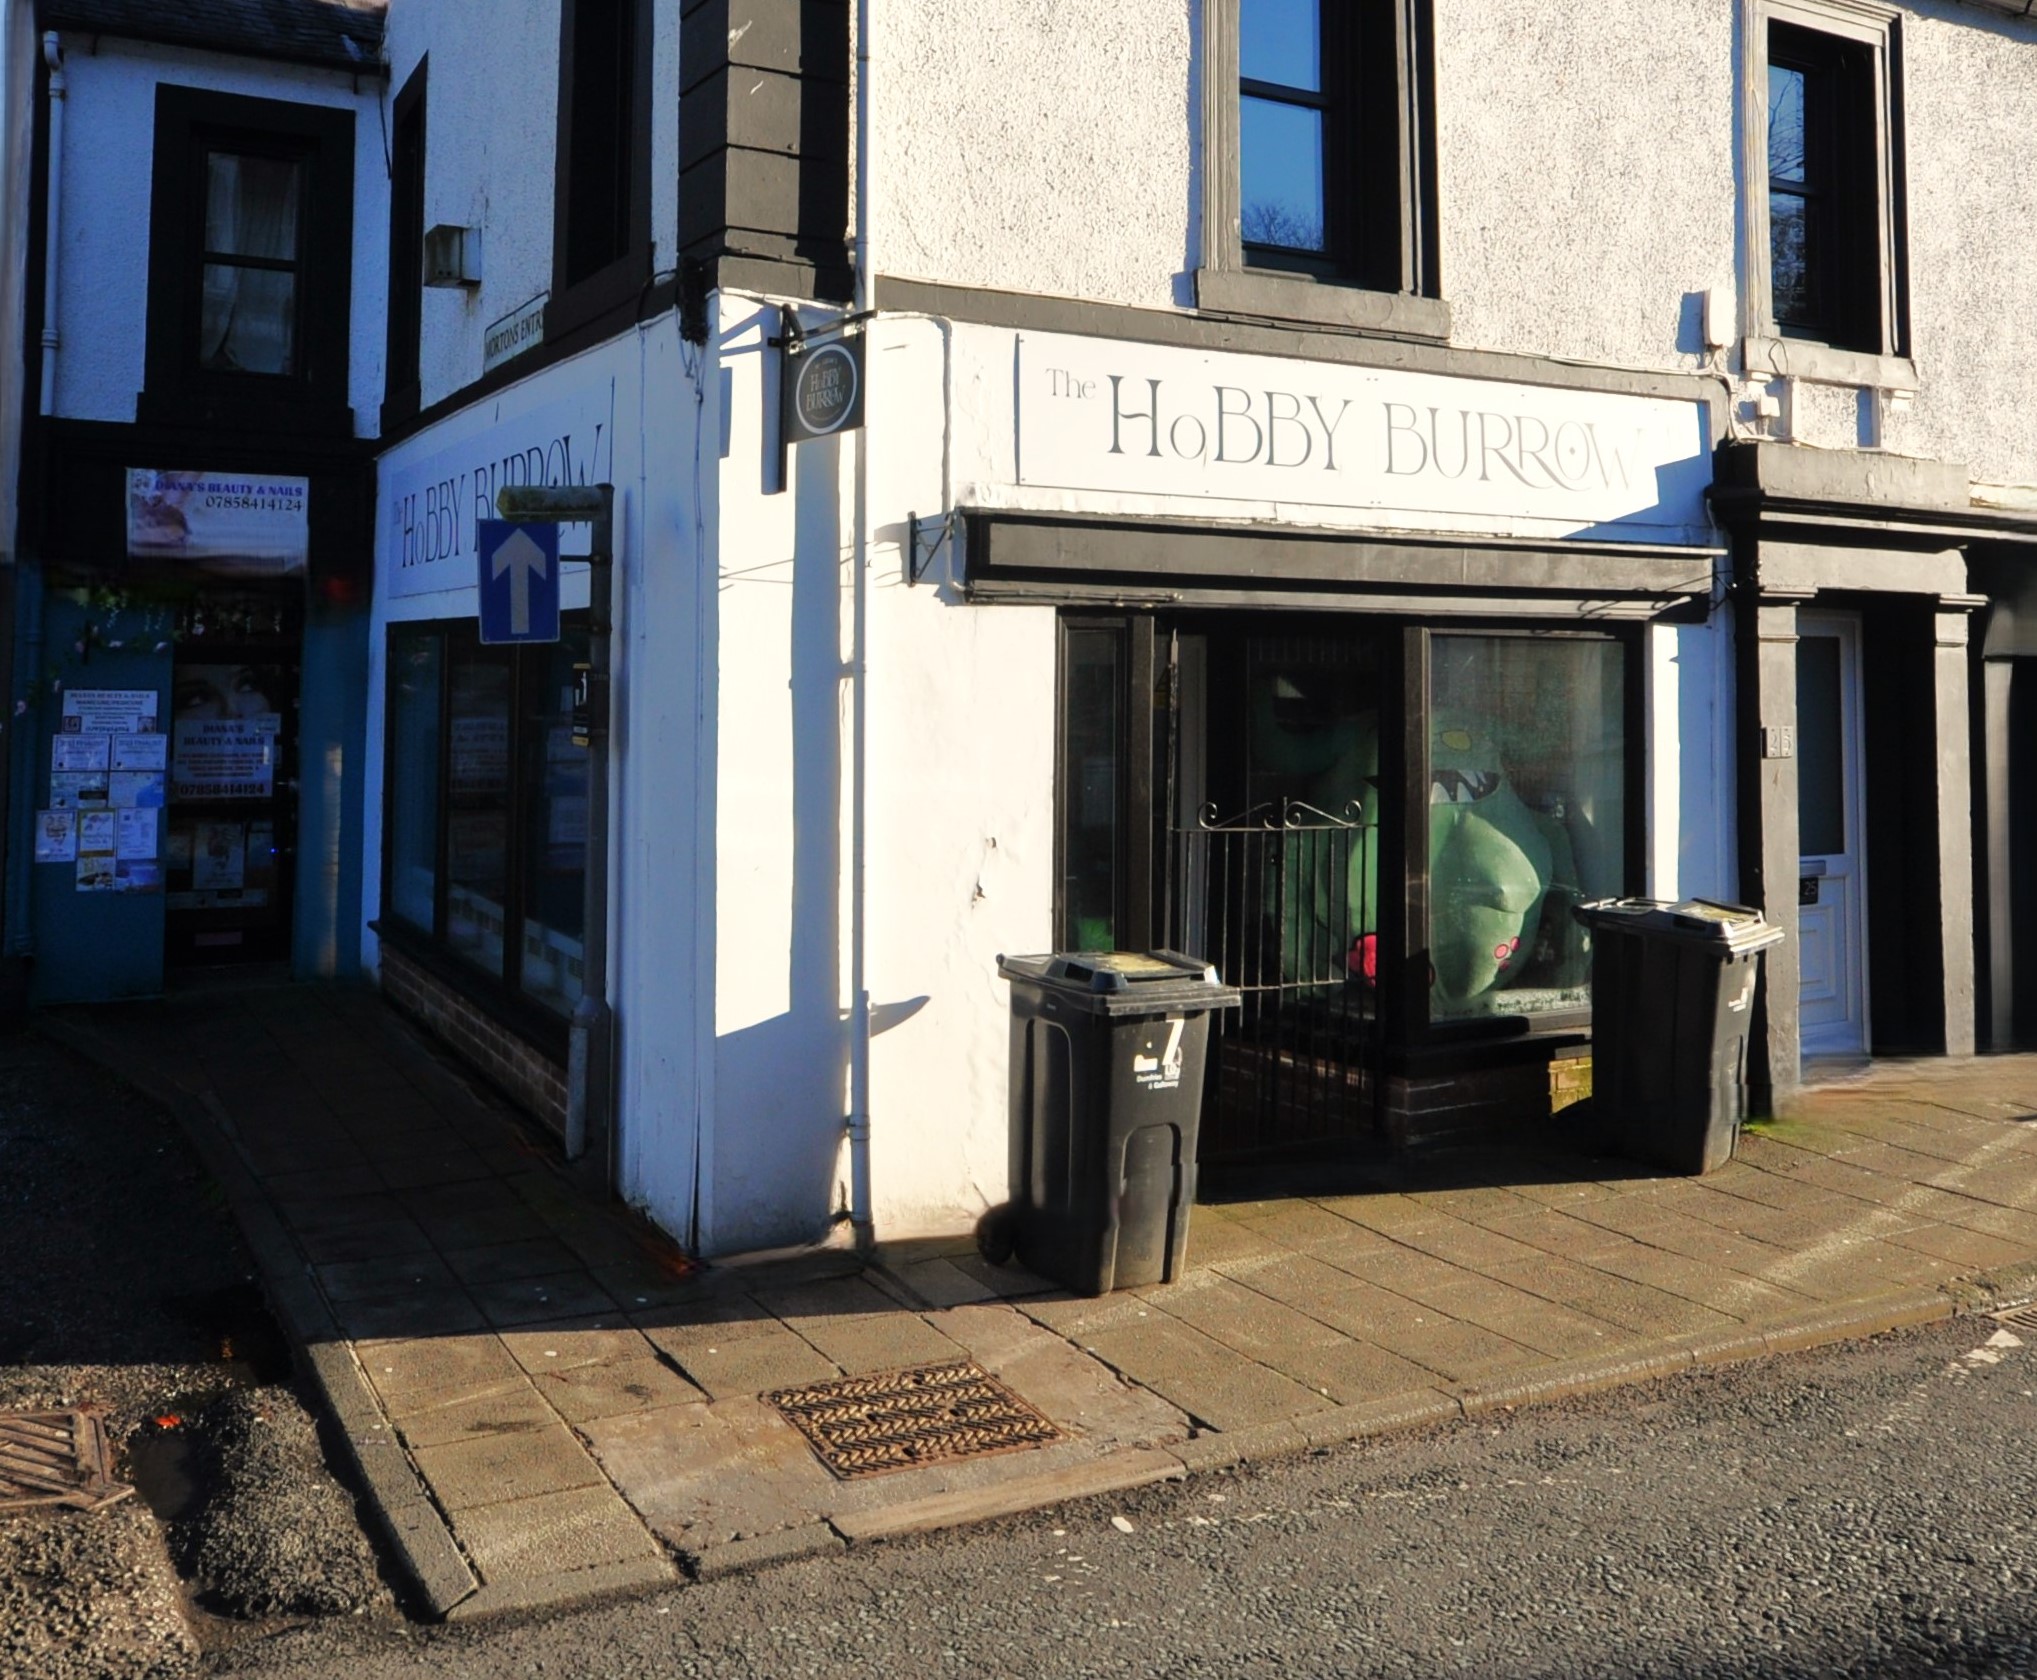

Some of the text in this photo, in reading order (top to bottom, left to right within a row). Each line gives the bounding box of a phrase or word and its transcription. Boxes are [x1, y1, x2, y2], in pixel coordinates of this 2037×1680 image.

[520, 308, 543, 340] ENTR
[1046, 368, 1096, 400] The
[1383, 402, 1644, 492] BURROW
[208, 483, 252, 495] BEAUTY
[256, 485, 265, 495] &
[269, 485, 303, 497] NAILS
[205, 495, 302, 513] 07858414124
